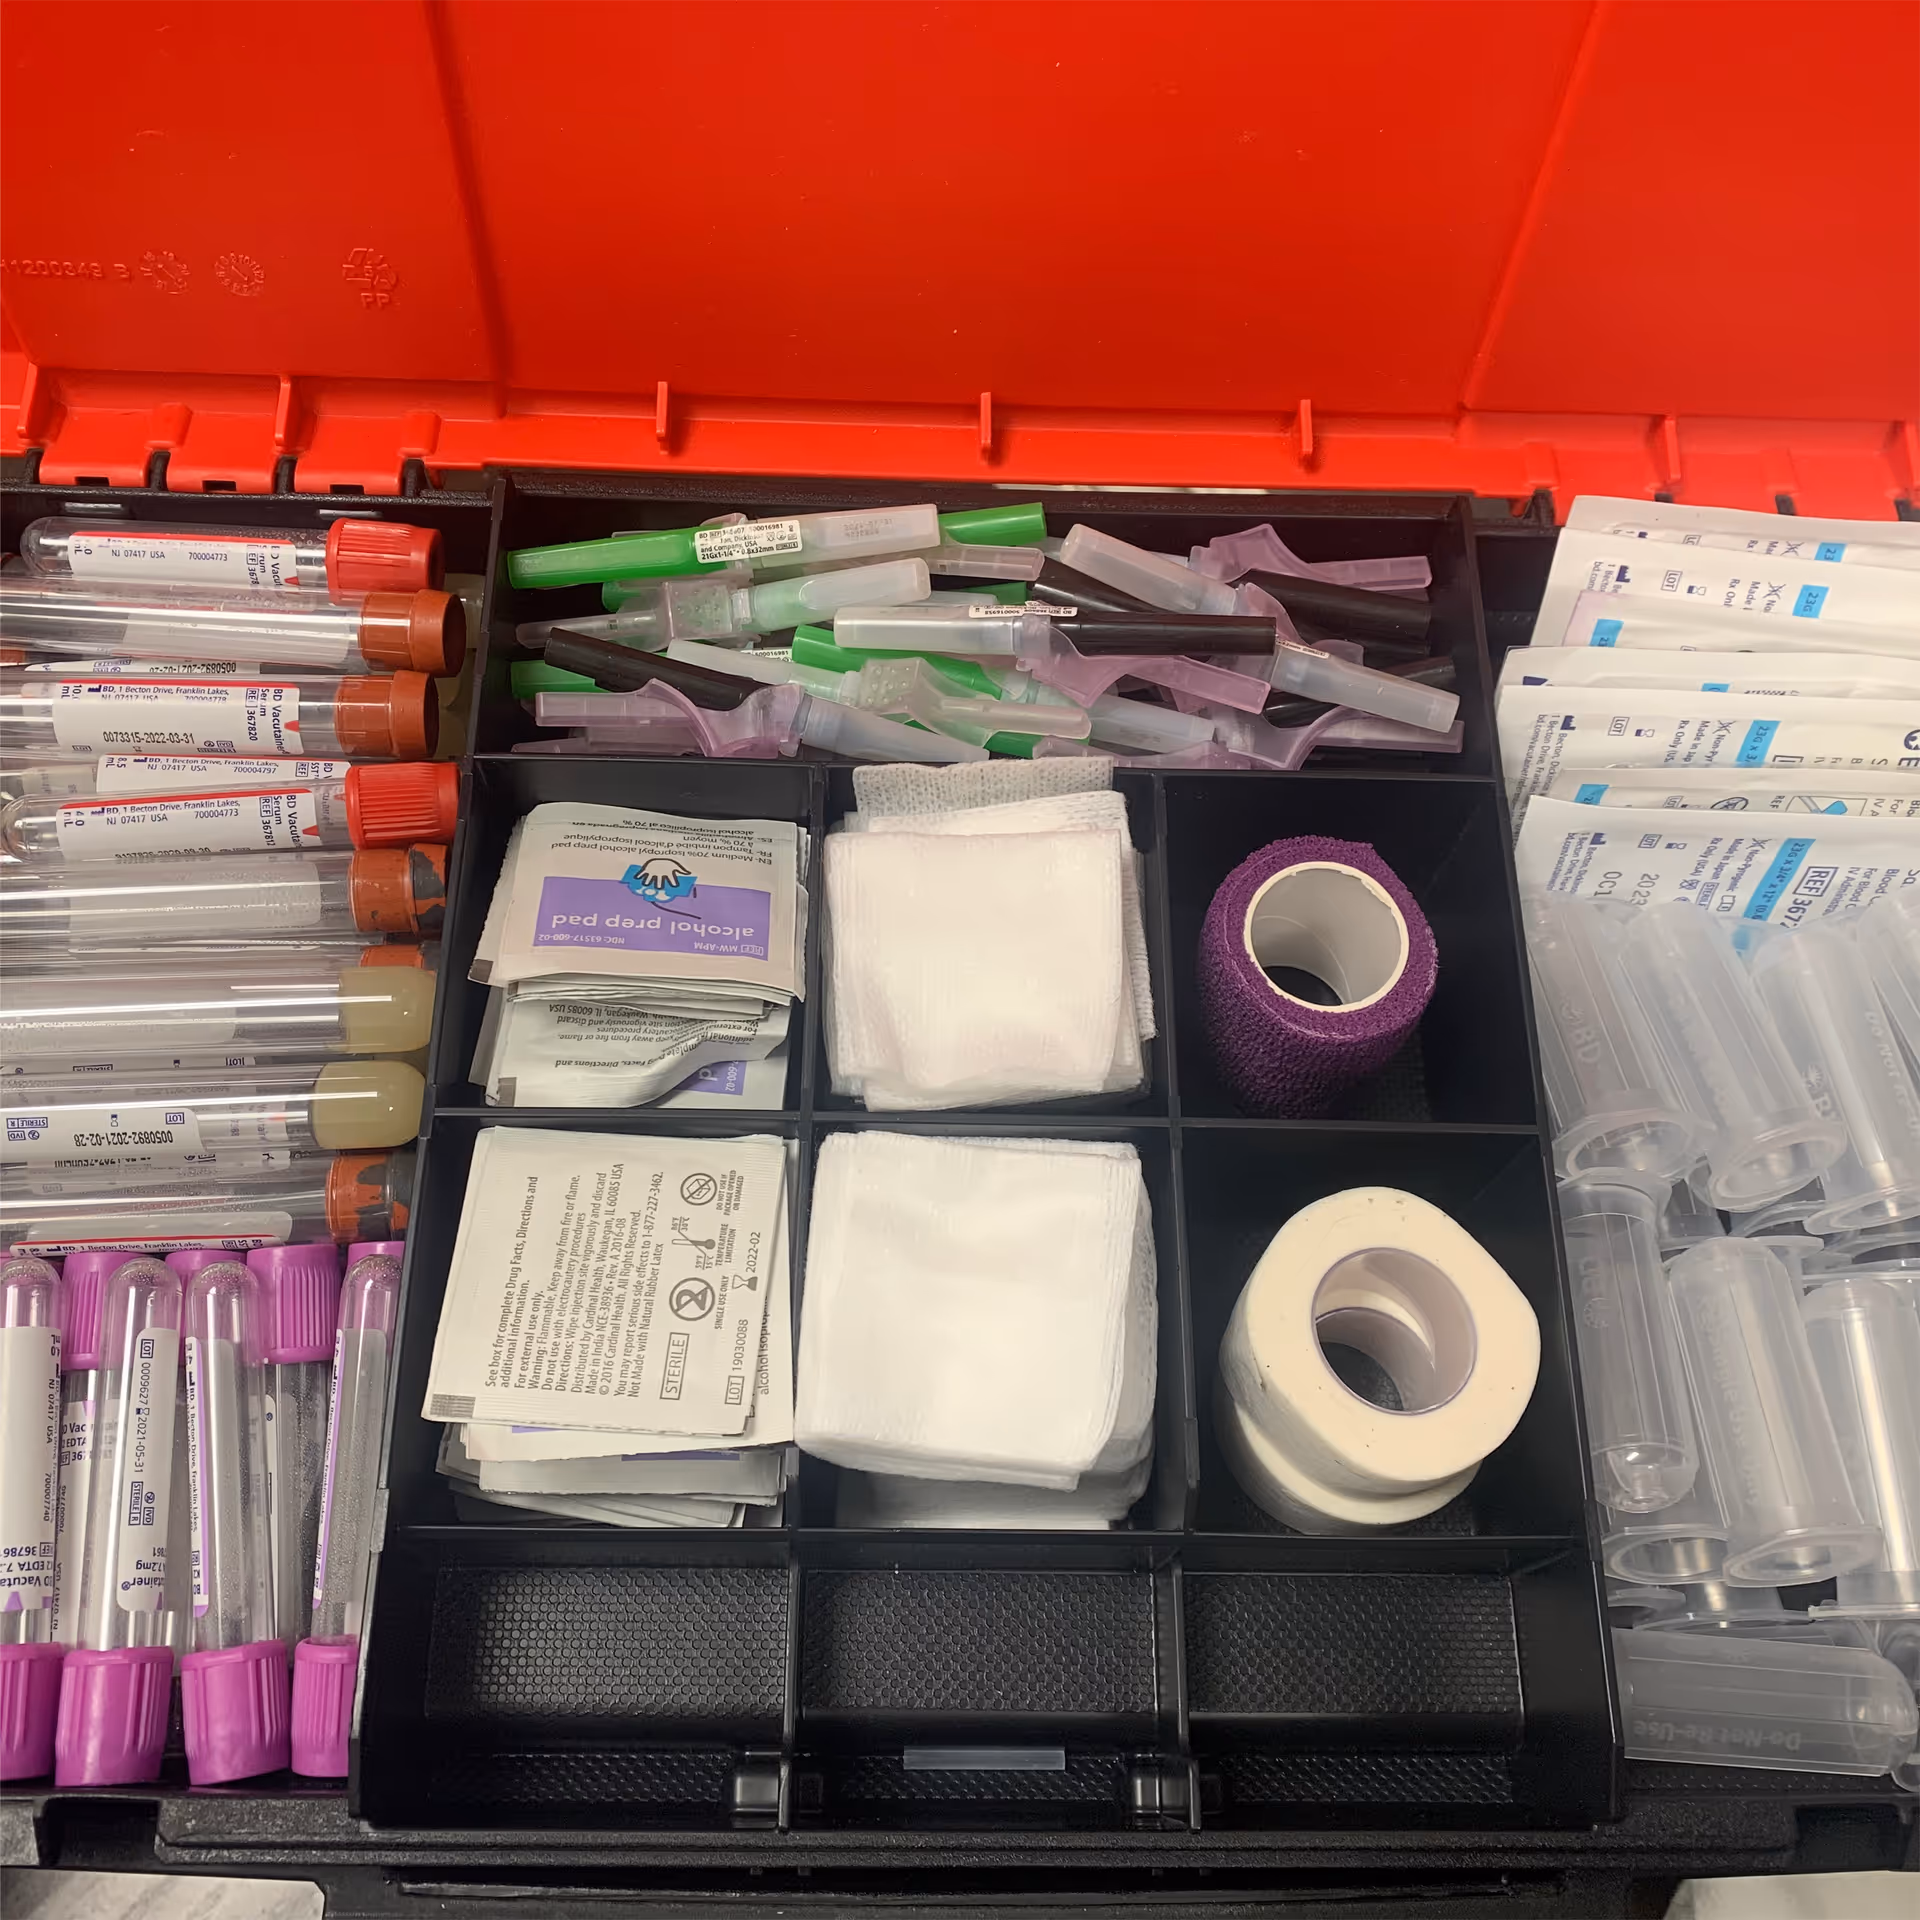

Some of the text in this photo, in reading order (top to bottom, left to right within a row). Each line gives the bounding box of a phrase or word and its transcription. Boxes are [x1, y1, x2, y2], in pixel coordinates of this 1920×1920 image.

[111, 549, 228, 562] NJ 07417 USA 700004773
[701, 545, 713, 553] and
[744, 540, 758, 548] USA
[1663, 572, 1680, 590] LOT
[1728, 578, 1741, 589] Rx
[1743, 580, 1761, 605] Made
[1802, 590, 1820, 613] 23G
[102, 685, 230, 696] BD, 1 Becton Drive, Franklin Lakes,
[272, 688, 283, 702] BD
[246, 709, 259, 742] 367820
[1610, 718, 1627, 735] LOT
[1671, 719, 1690, 750] Rx Only
[102, 730, 196, 745] 0073315-2022-03-31
[1749, 725, 1772, 752] 23G x
[147, 763, 278, 775] NJ 07417 USA 700004797
[323, 762, 334, 774] BD
[123, 805, 128, 814] 1
[130, 803, 158, 814] Becton
[159, 802, 183, 813] Drive,
[183, 800, 215, 811] Franklin
[217, 798, 241, 810] Lakes,
[261, 798, 271, 817] REF
[272, 794, 283, 826] Serum
[286, 794, 297, 809] BD
[106, 808, 239, 826] NJ 07417 USA 700004773
[563, 833, 633, 846] isopropylique
[675, 841, 711, 851] imbibé
[712, 843, 754, 855] Tampon
[1642, 835, 1658, 848] LOT
[1787, 841, 1806, 858] 23G
[550, 840, 772, 866] EN- Medium 70% Isopropyl alcohol prep pad
[1689, 837, 1724, 877] Rx Only (USA)
[1711, 838, 1745, 880] Made in Japan
[1726, 848, 1761, 893] Non-Pyrogenic
[1802, 869, 1830, 895] REF
[1874, 868, 1900, 895] Blood
[1849, 867, 1879, 909] For Blood
[551, 913, 755, 941] alcohol prep pad
[693, 941, 738, 953] MW-APM
[548, 1003, 603, 1016] IL 60085 USA
[555, 1059, 574, 1068] and
[574, 1059, 619, 1069] Directions
[19, 1118, 46, 1127] STERILE
[167, 1114, 183, 1123] LOT
[10, 1132, 23, 1140] IVD
[74, 1129, 174, 1148] 0050892-2021-02-28
[610, 1217, 627, 1253] 2016-08
[714, 1223, 729, 1266] TEMPERATURE
[724, 1228, 737, 1263] LIMITATION
[745, 1231, 761, 1274] 2022-02
[484, 1176, 538, 1387] See box for complete Drug Facts, Directions and
[570, 1163, 624, 1393] Distributed by Cardinal Health, Waukegan, IL 60085 USA
[605, 1263, 619, 1280] Rev.
[613, 1171, 664, 1397] You may report serious side effects to 1-877-227-3462.
[595, 1286, 615, 1332] NCE-38936
[714, 1275, 729, 1330] SINGLE USE ONLY
[499, 1279, 530, 1388] additional information.
[591, 1333, 605, 1356] India
[591, 1358, 601, 1367] in
[664, 1339, 686, 1394] STERILE
[728, 1318, 749, 1401] LOT 19030088
[584, 1368, 600, 1395] Made
[756, 1352, 770, 1395] alcohol
[46, 1378, 55, 1444] NJ 07417 USA
[134, 1340, 153, 1473] LOT 0009627 2021-05-31
[43, 1472, 52, 1523] 700007740
[131, 1483, 142, 1523] STERILE R
[145, 1508, 153, 1525] IVD
[17, 1560, 45, 1571] EDTA
